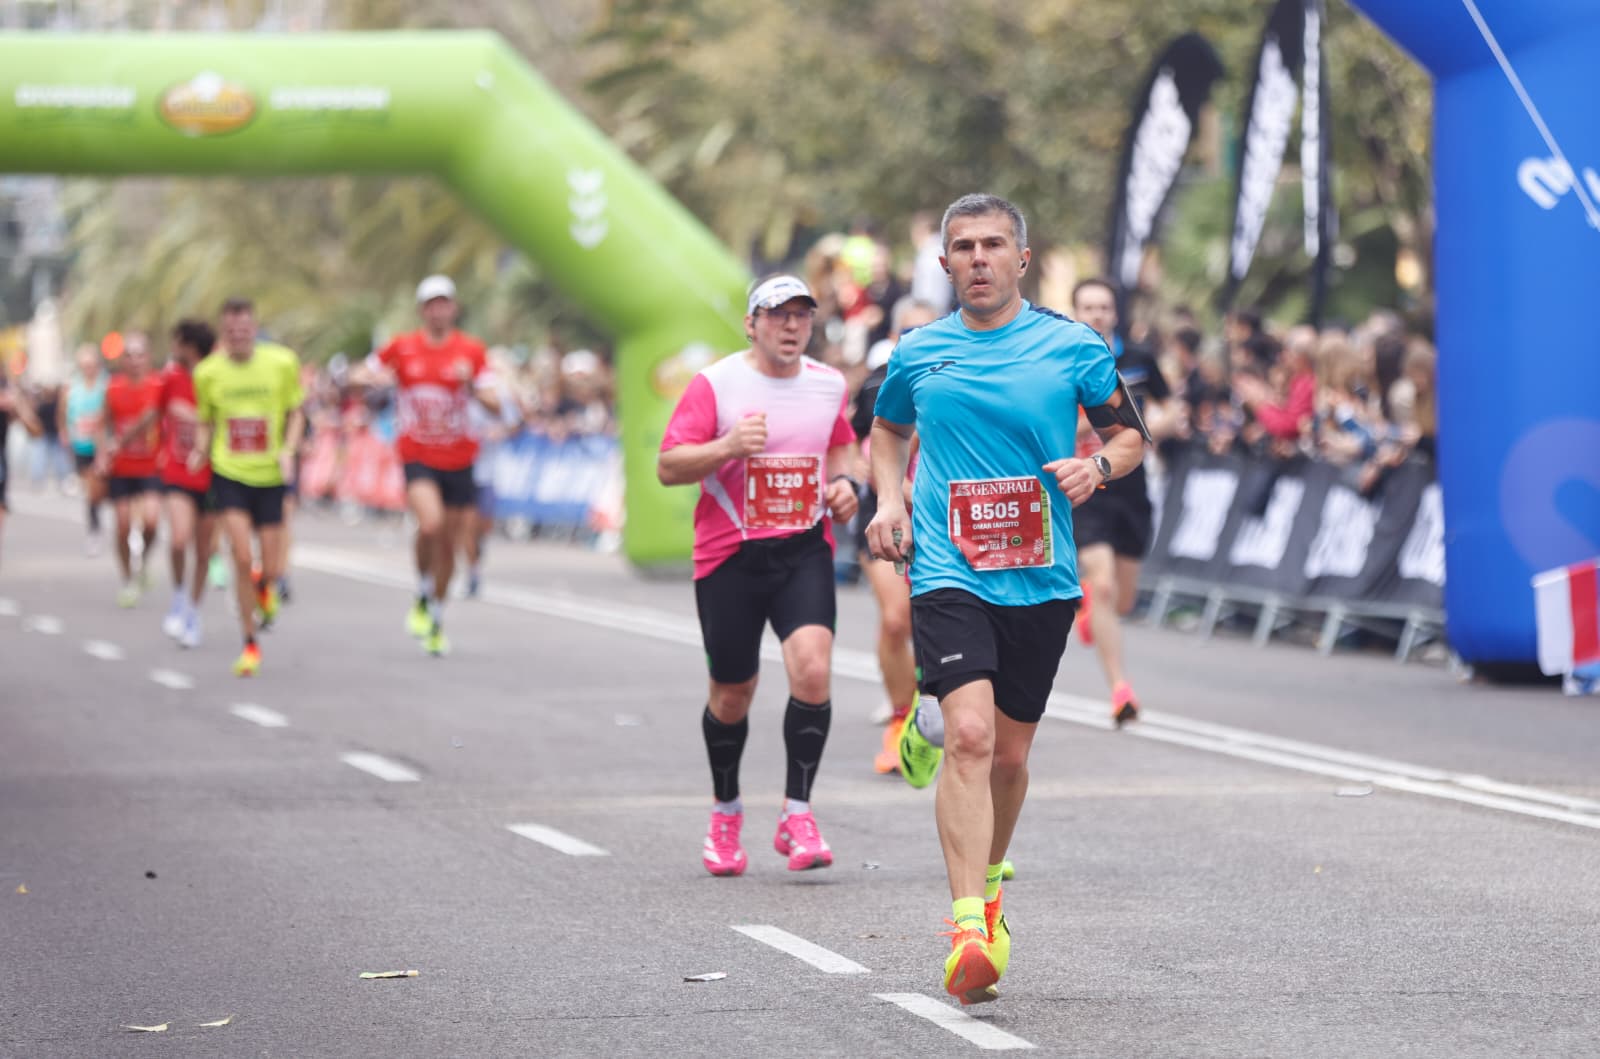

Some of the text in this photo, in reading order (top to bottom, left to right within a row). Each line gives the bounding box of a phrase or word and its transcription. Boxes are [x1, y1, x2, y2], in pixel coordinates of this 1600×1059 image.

[765, 473, 803, 488] 1320
[971, 480, 1034, 496] GENERALI
[970, 501, 1020, 521] 8505
